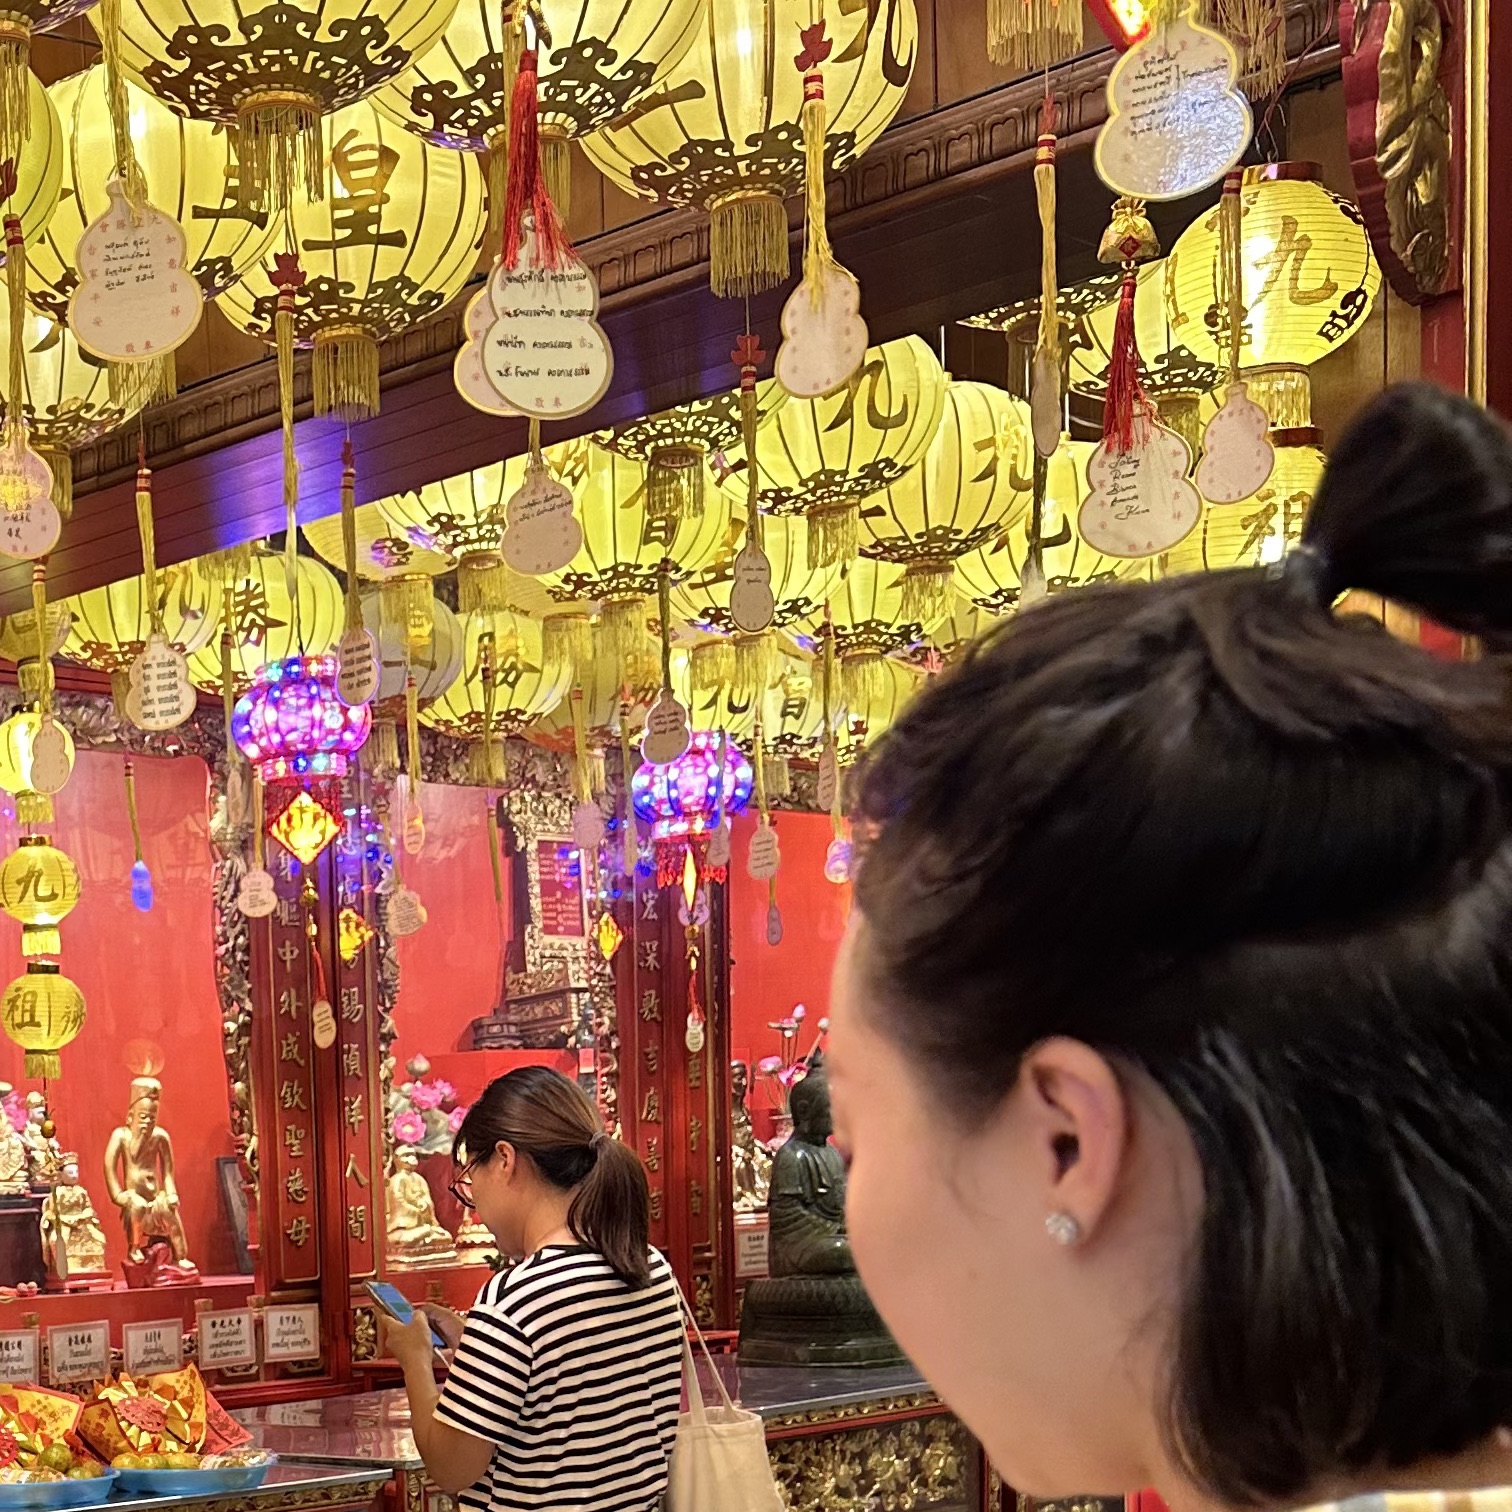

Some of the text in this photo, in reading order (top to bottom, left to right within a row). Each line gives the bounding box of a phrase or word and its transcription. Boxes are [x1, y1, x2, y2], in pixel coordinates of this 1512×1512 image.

[302, 128, 407, 252] 皇
[1248, 215, 1338, 312] 九
[822, 359, 909, 433] 九
[17, 867, 59, 904] 九
[6, 986, 42, 1030] 祖
